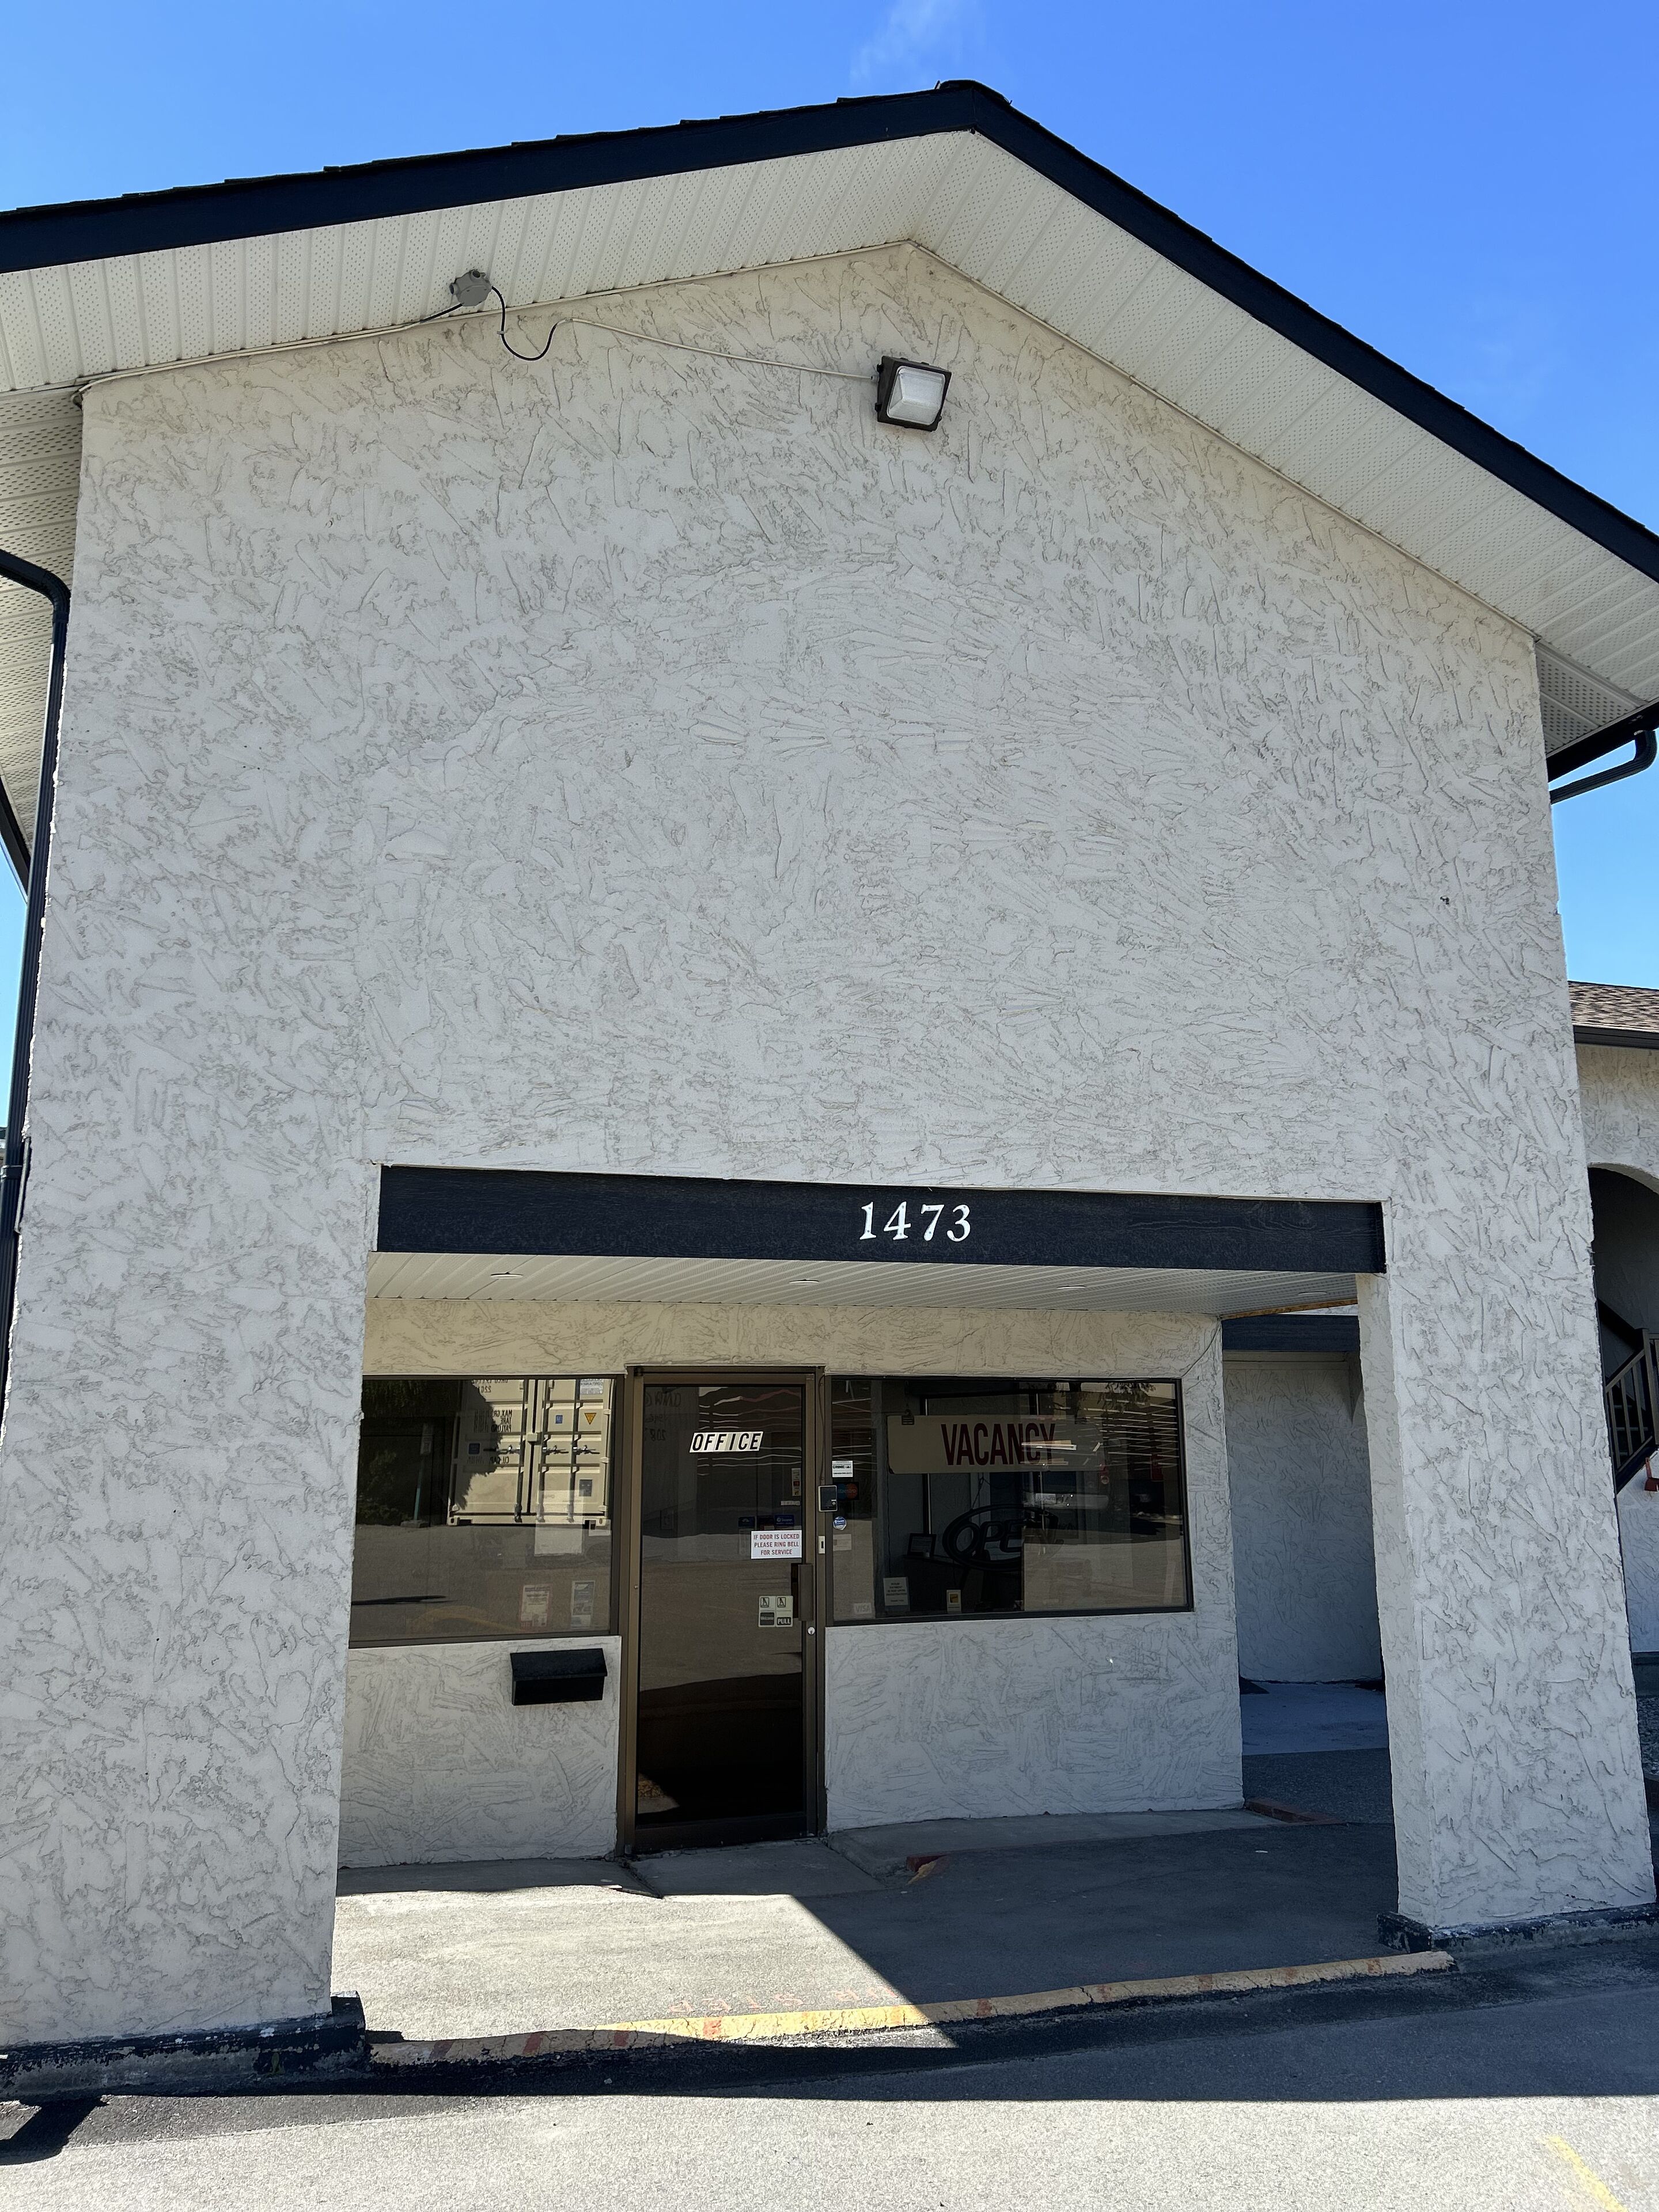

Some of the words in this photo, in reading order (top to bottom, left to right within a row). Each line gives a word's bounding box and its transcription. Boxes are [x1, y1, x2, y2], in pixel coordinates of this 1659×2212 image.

[859, 1201, 971, 1242] 1473
[692, 1433, 761, 1451] OFFICE
[941, 1423, 1055, 1465] VACANCY
